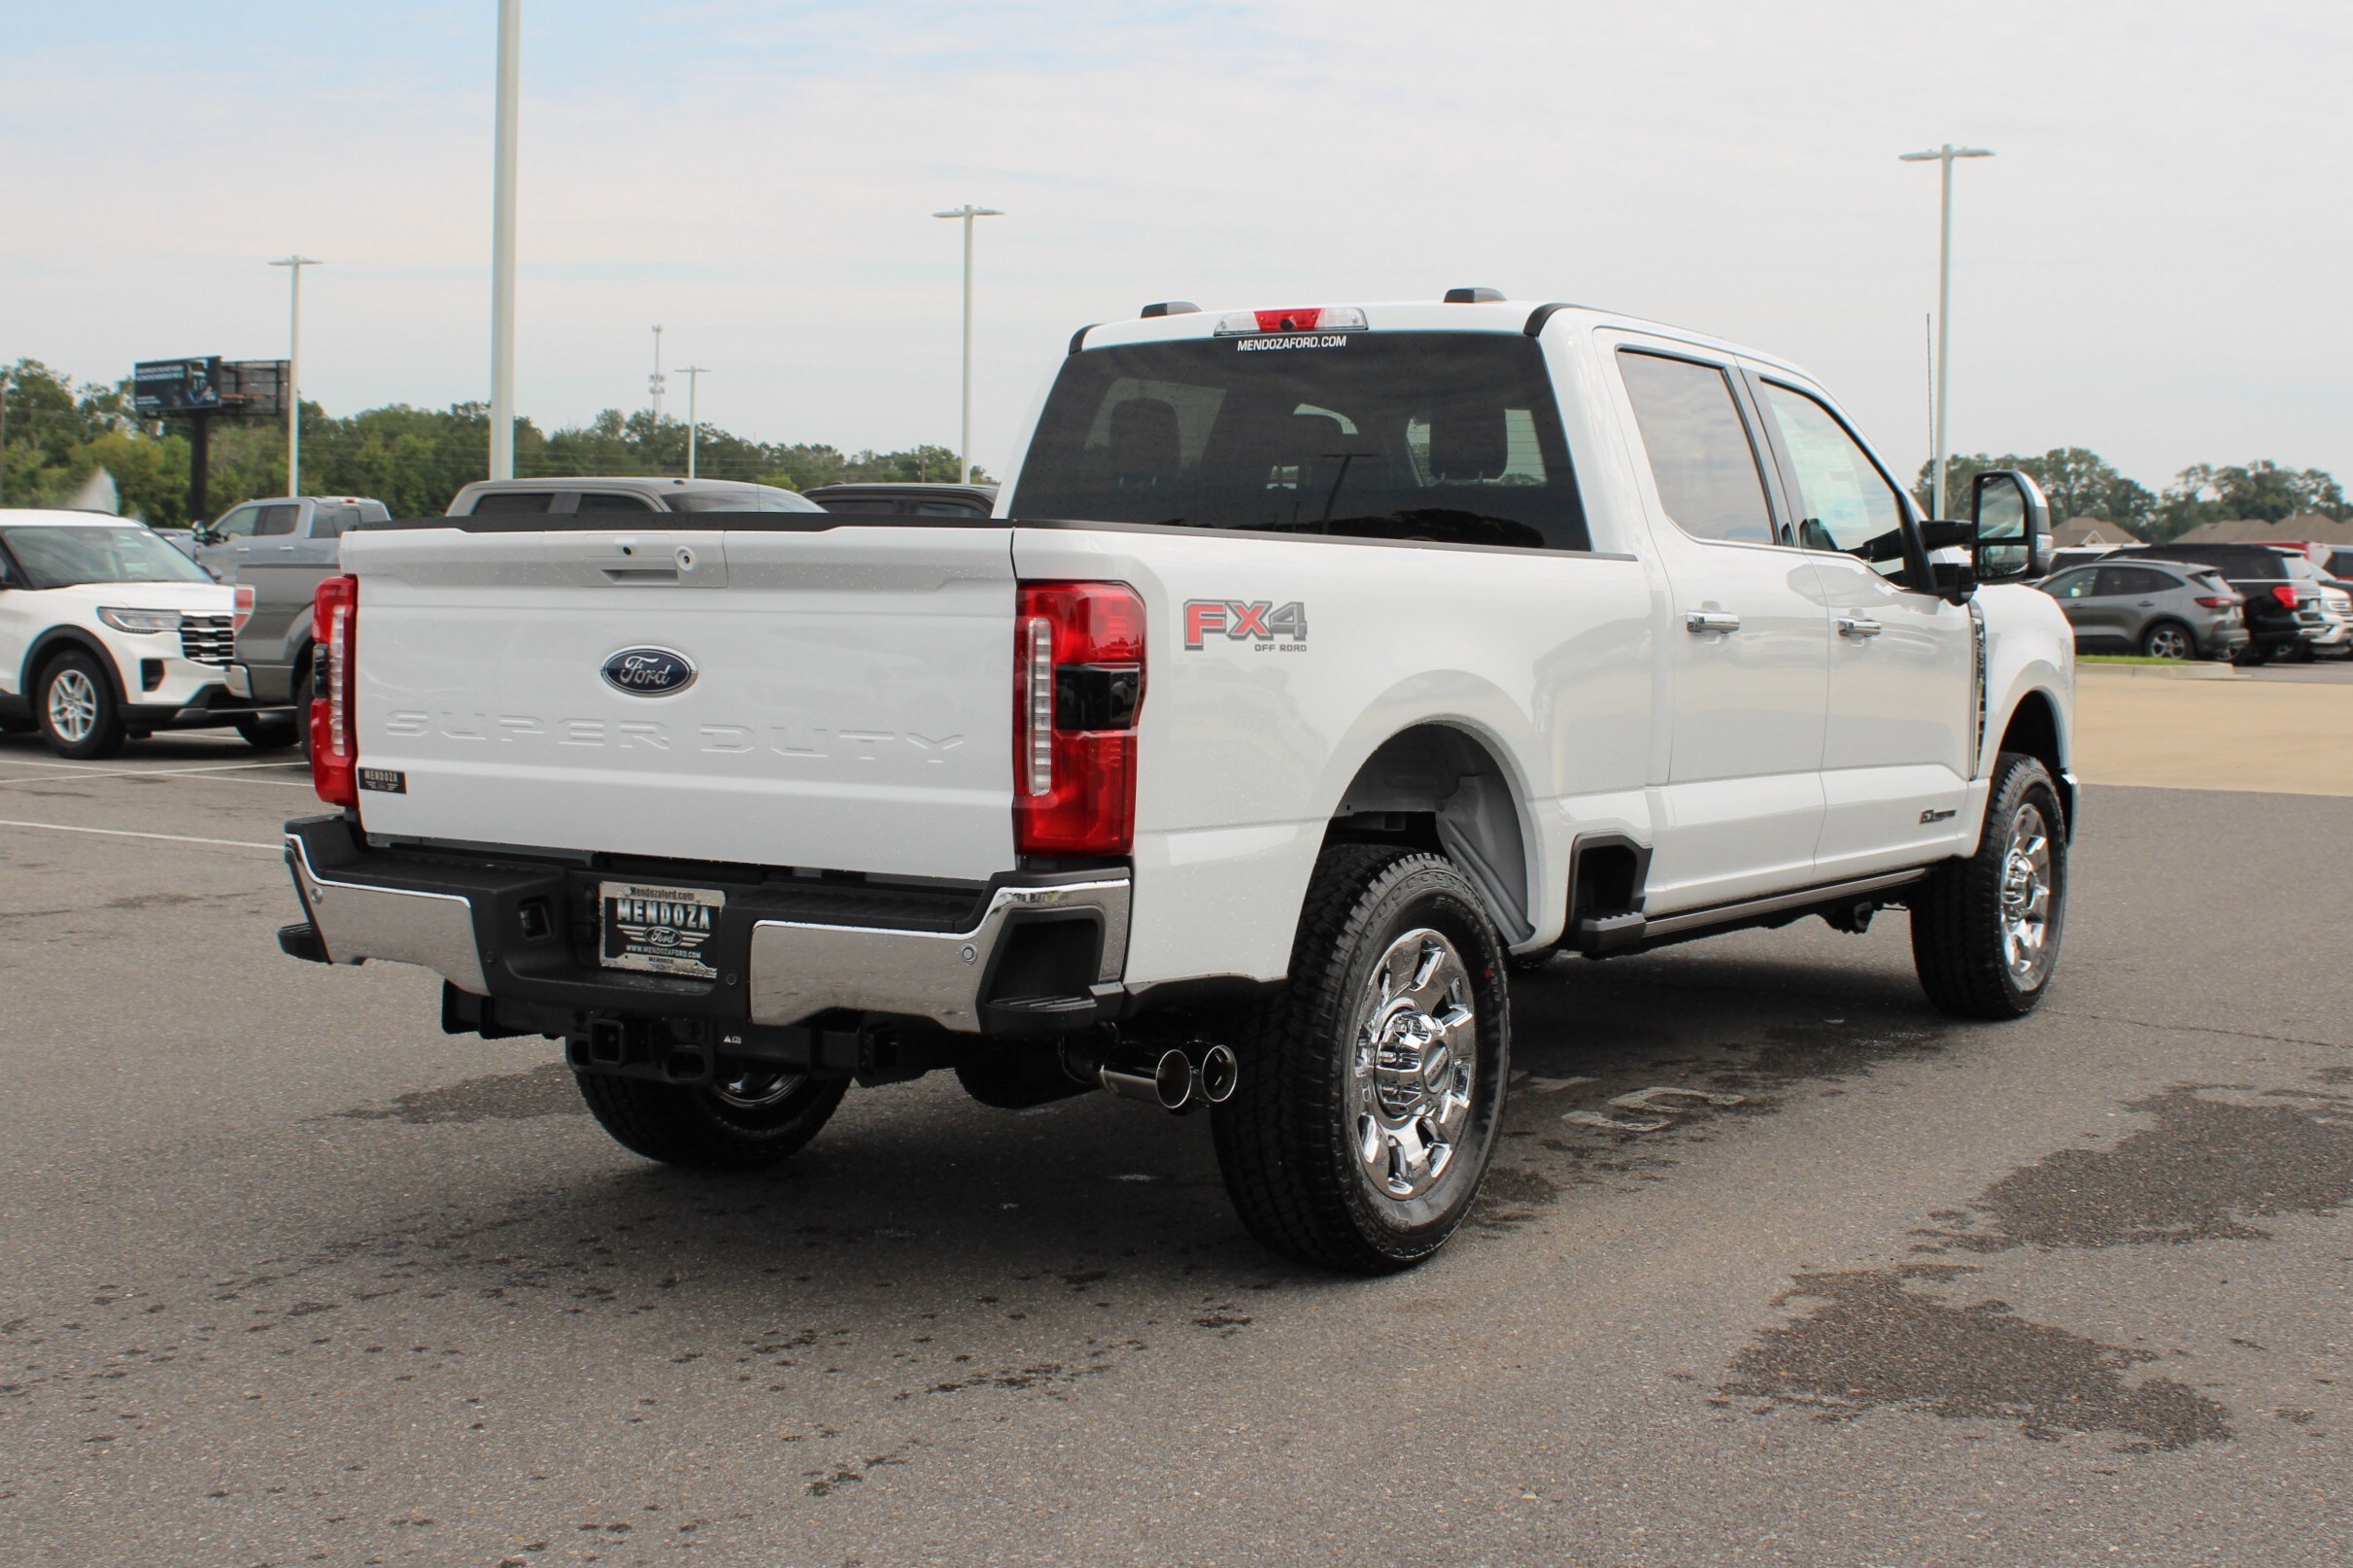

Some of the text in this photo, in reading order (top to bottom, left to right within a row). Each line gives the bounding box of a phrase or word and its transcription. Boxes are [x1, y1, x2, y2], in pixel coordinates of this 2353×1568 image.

[1237, 335, 1347, 352] MENDOZAFORD.COM
[1183, 598, 1308, 652] FX4
[1254, 643, 1307, 652] OFF ROAD
[619, 655, 670, 686] Ford
[387, 710, 966, 764] SUPER DUTY
[364, 769, 398, 782] MENDOZA
[630, 886, 695, 901] Mendozaford.com
[617, 898, 710, 930] MENDOZA
[650, 929, 674, 944] Ford
[626, 944, 701, 959] WWW.MENDOZAFORD.COM
